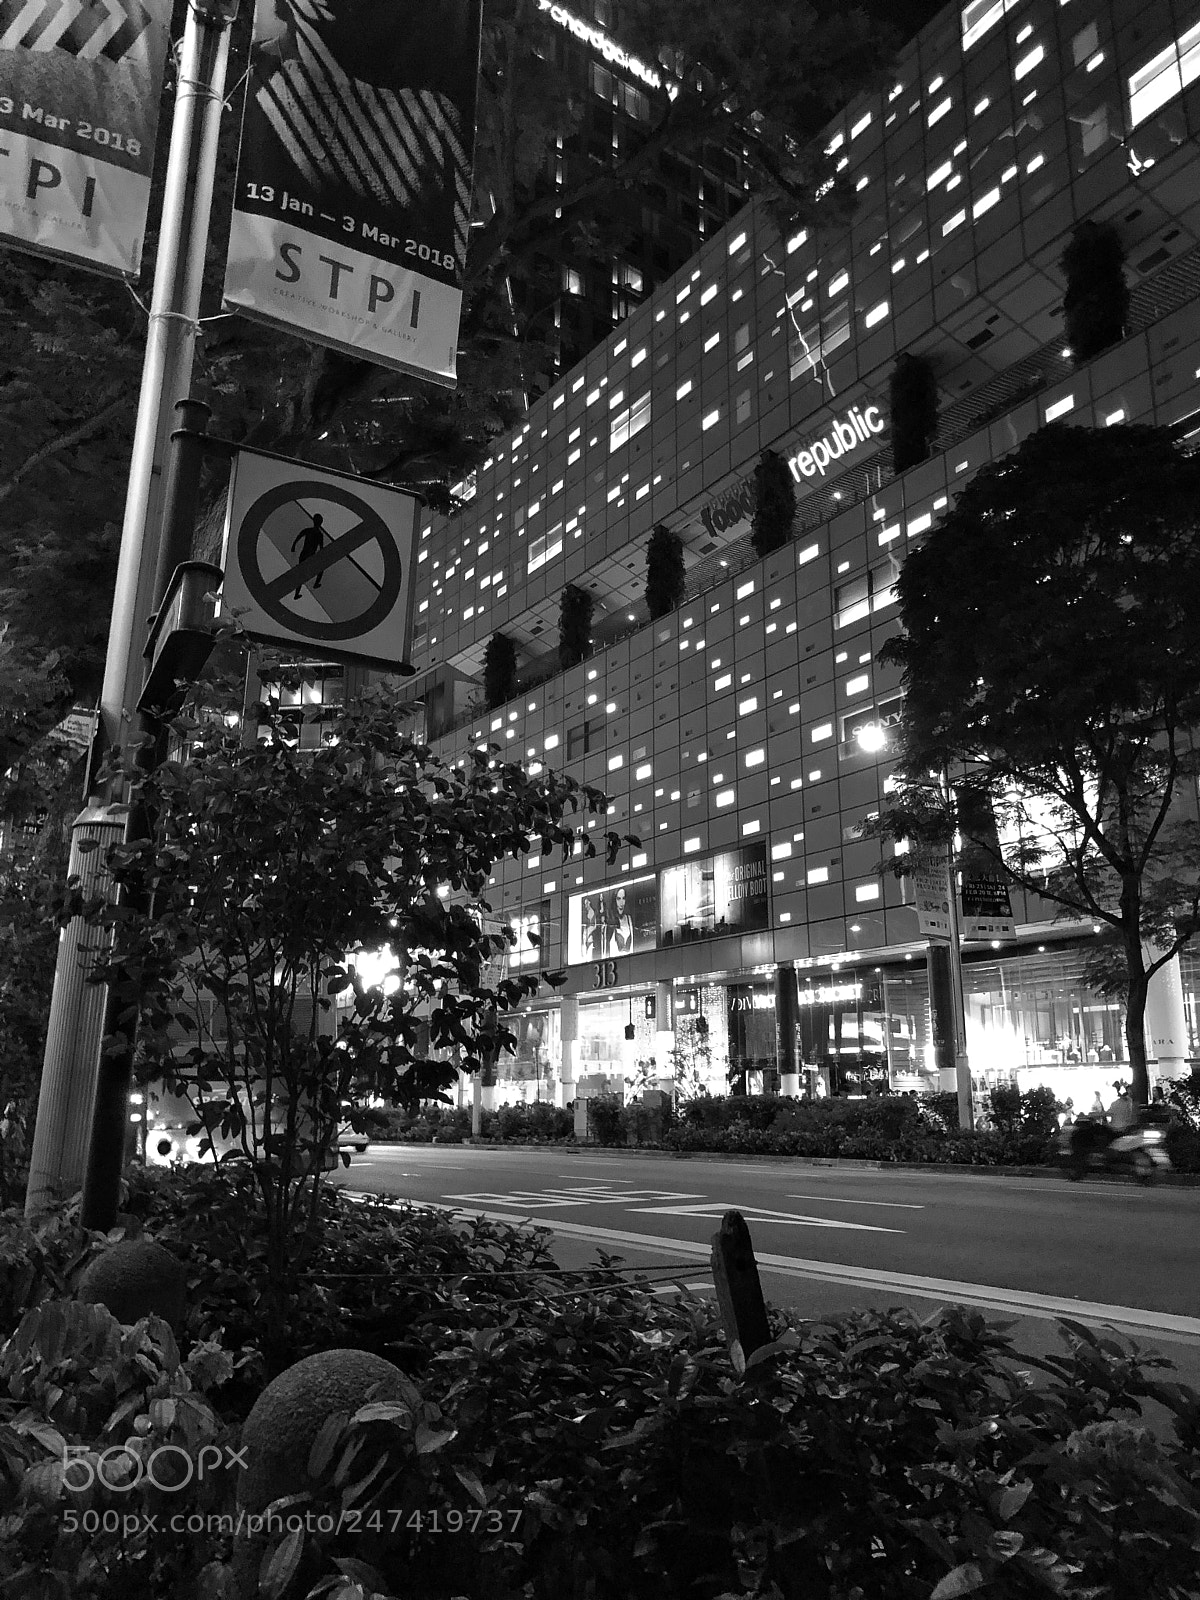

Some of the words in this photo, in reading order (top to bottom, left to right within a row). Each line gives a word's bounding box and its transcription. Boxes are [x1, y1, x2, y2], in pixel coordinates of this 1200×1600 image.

[0, 97, 14, 114] 3
[22, 103, 71, 131] Mar
[76, 121, 142, 156] 2018
[246, 182, 275, 202] 13
[280, 191, 314, 216] Jan
[342, 215, 356, 233] 3
[361, 222, 401, 249] Mar
[405, 239, 455, 271] 2018
[274, 242, 422, 329] STPI
[272, 287, 316, 308] CREATIVE
[318, 303, 370, 326] WORKSHOP
[788, 405, 885, 483] republic
[727, 882, 749, 899] ELLOW
[750, 878, 768, 896] BOOT
[734, 860, 767, 881] ORIGINAL
[592, 961, 617, 989] 313
[440, 1186, 709, 1208] BUS
